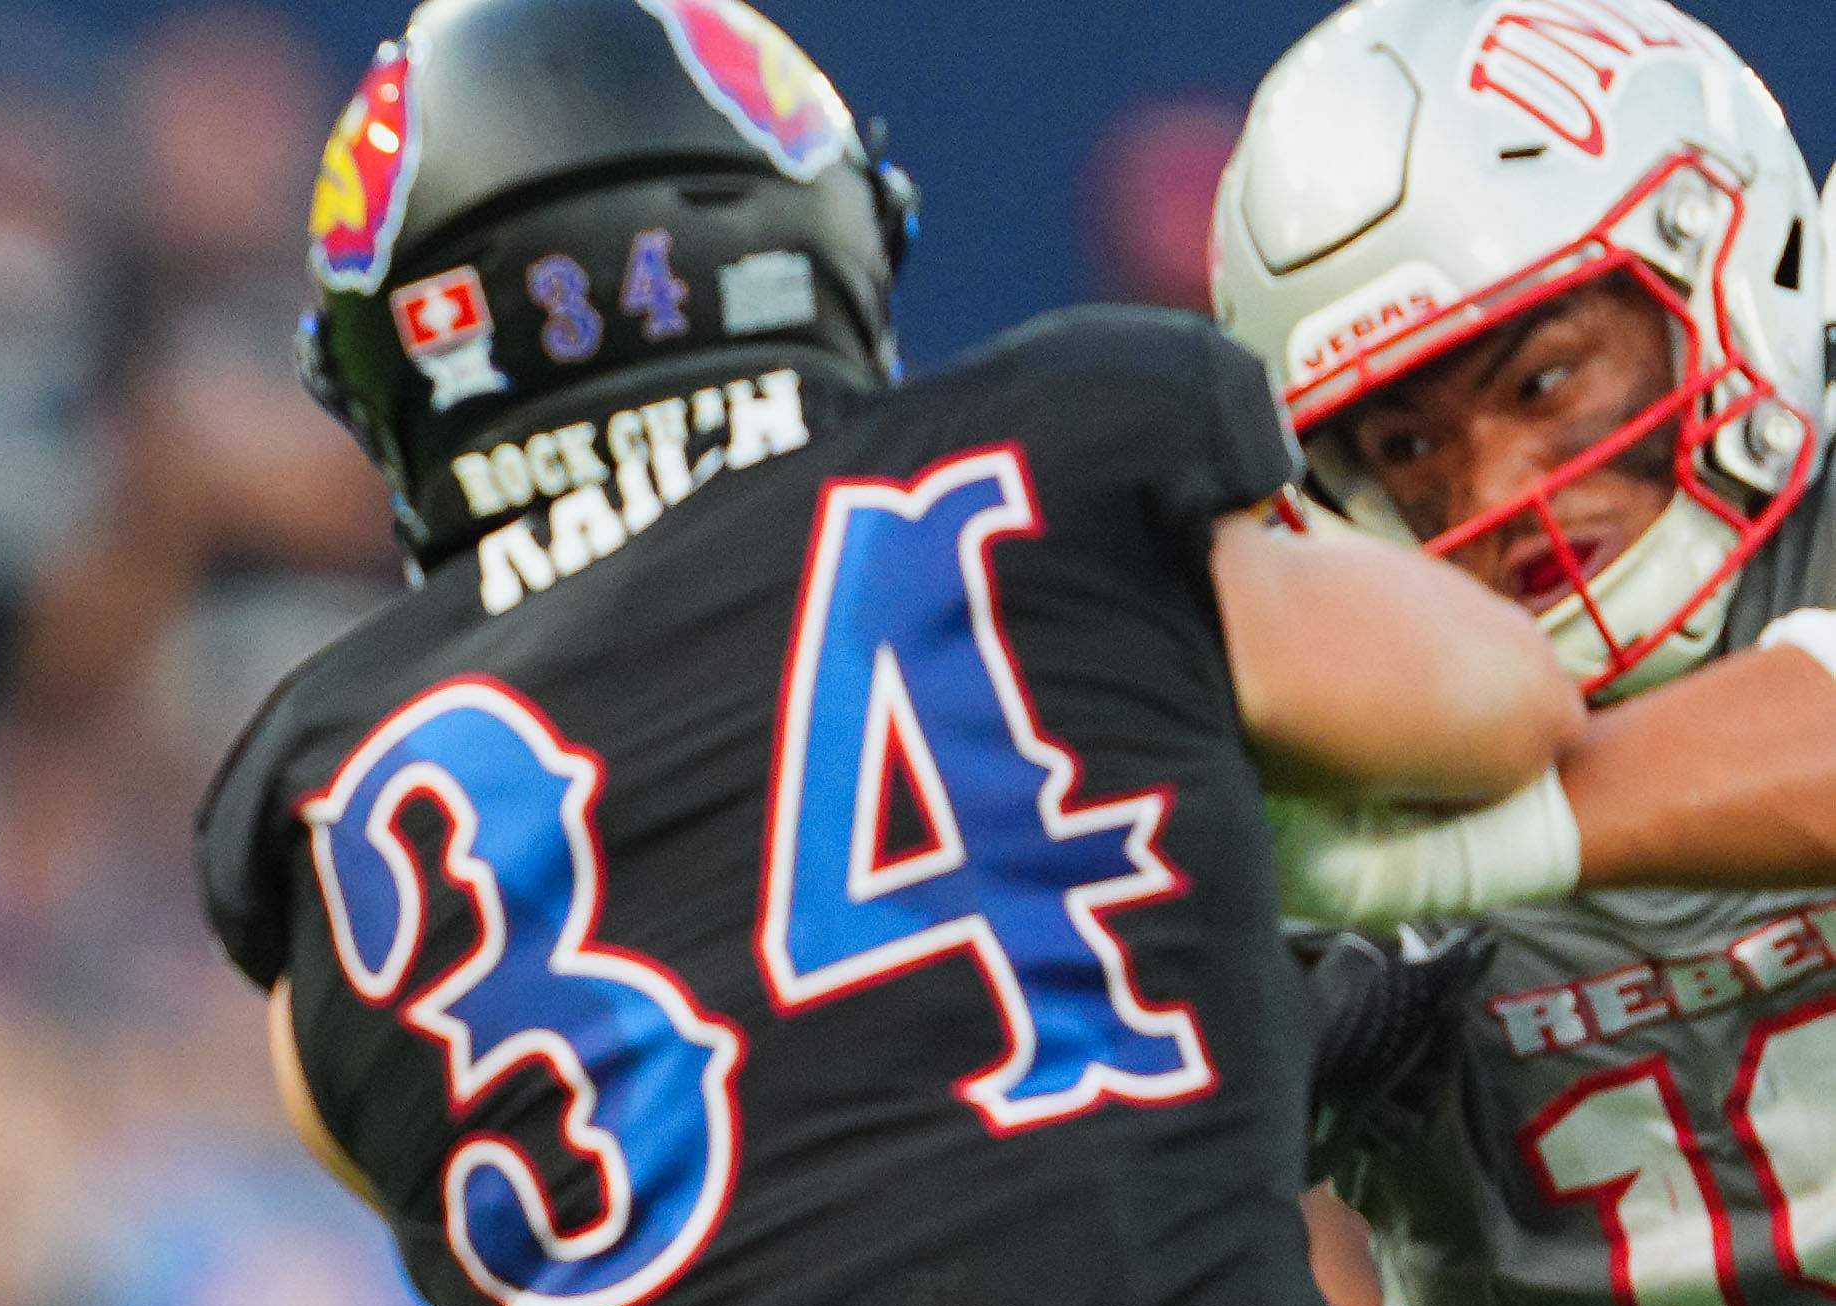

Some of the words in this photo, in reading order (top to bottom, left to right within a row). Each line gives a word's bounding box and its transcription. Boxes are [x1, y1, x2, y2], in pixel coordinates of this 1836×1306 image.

[1469, 0, 1691, 157] UNL
[526, 226, 690, 363] 34
[450, 421, 611, 518] ROCK
